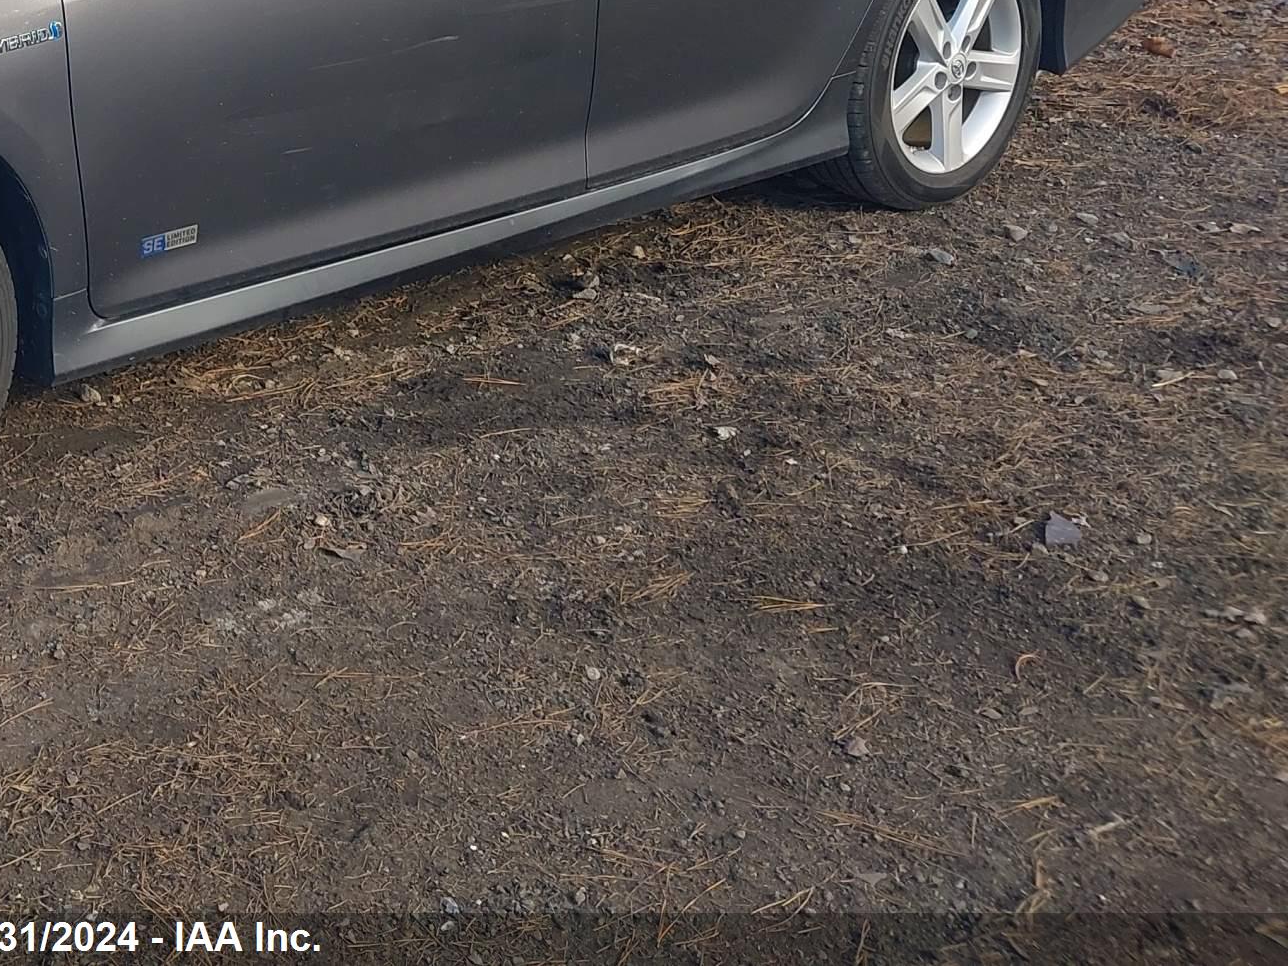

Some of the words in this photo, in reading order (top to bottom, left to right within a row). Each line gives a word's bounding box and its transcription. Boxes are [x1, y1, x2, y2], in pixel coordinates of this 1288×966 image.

[166, 227, 195, 241] LIMITED
[142, 236, 164, 254] SE
[166, 235, 195, 248] EDITION
